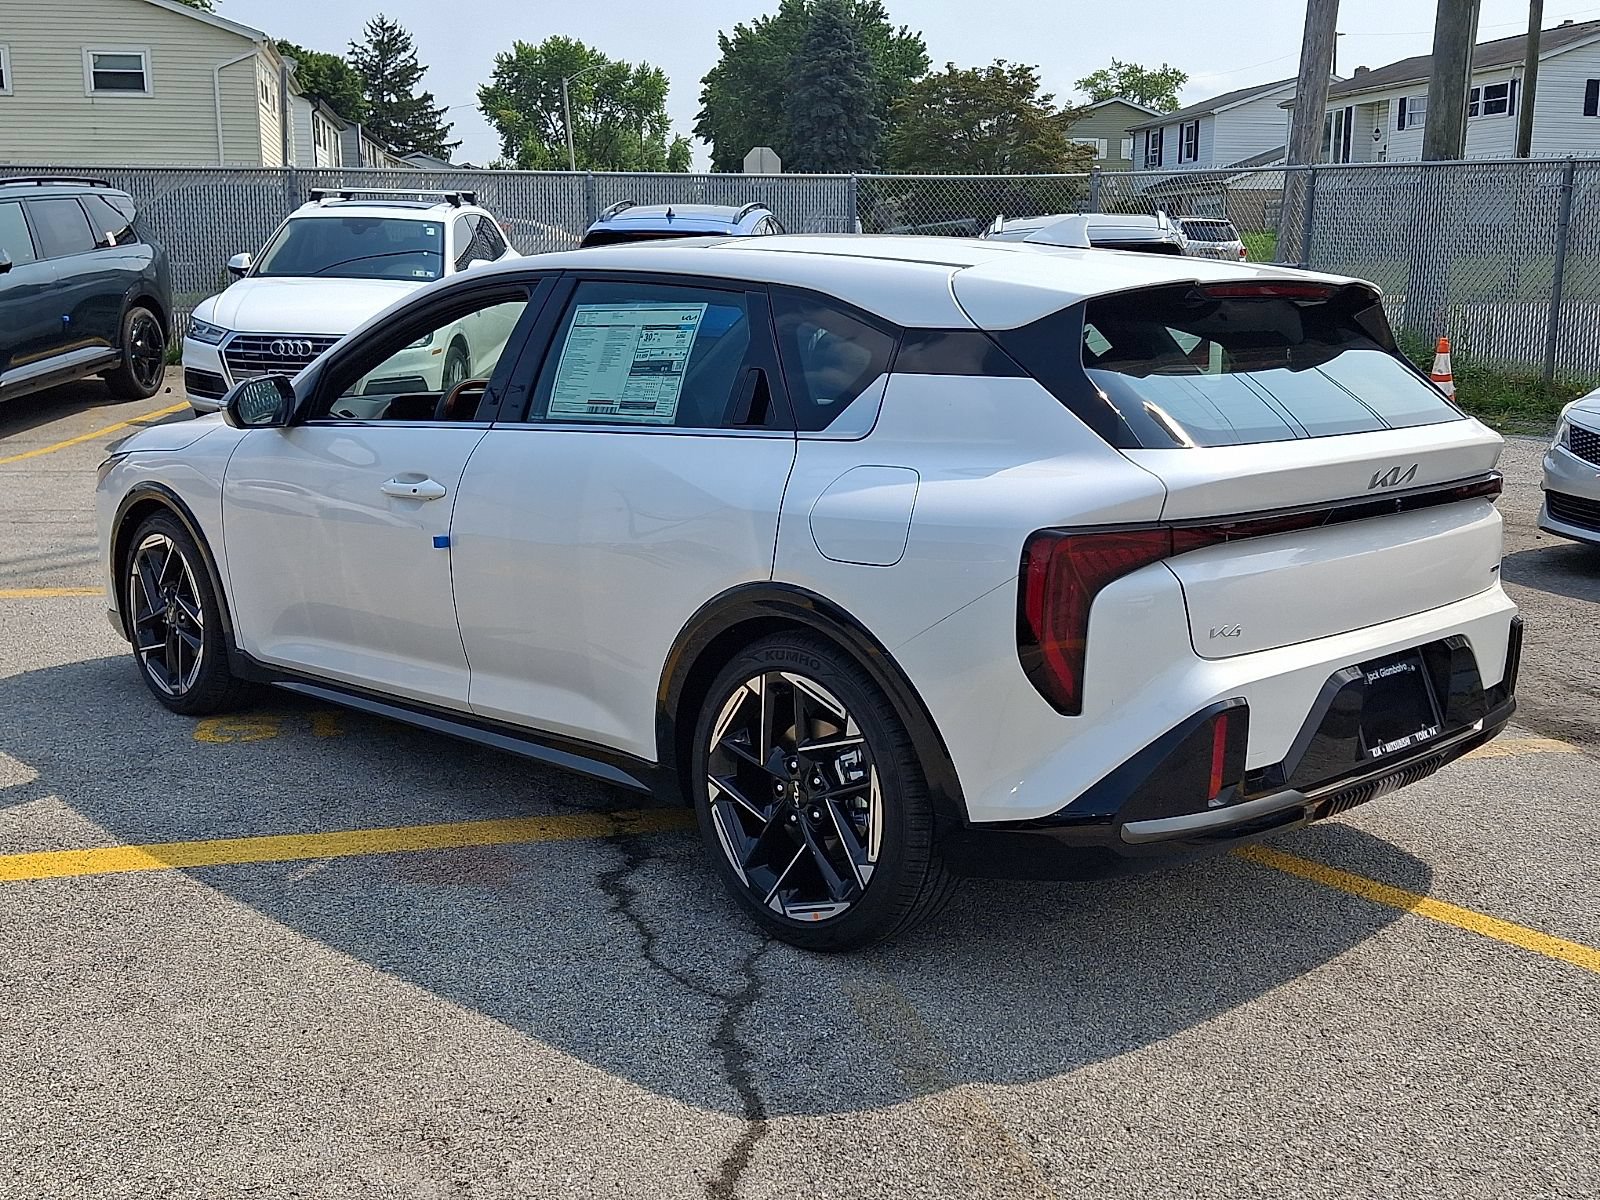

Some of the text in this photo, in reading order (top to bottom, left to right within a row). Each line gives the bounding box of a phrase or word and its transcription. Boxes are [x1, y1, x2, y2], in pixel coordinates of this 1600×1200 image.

[1367, 463, 1419, 490] KIA
[1209, 623, 1242, 639] K4
[764, 649, 821, 671] KUMHO
